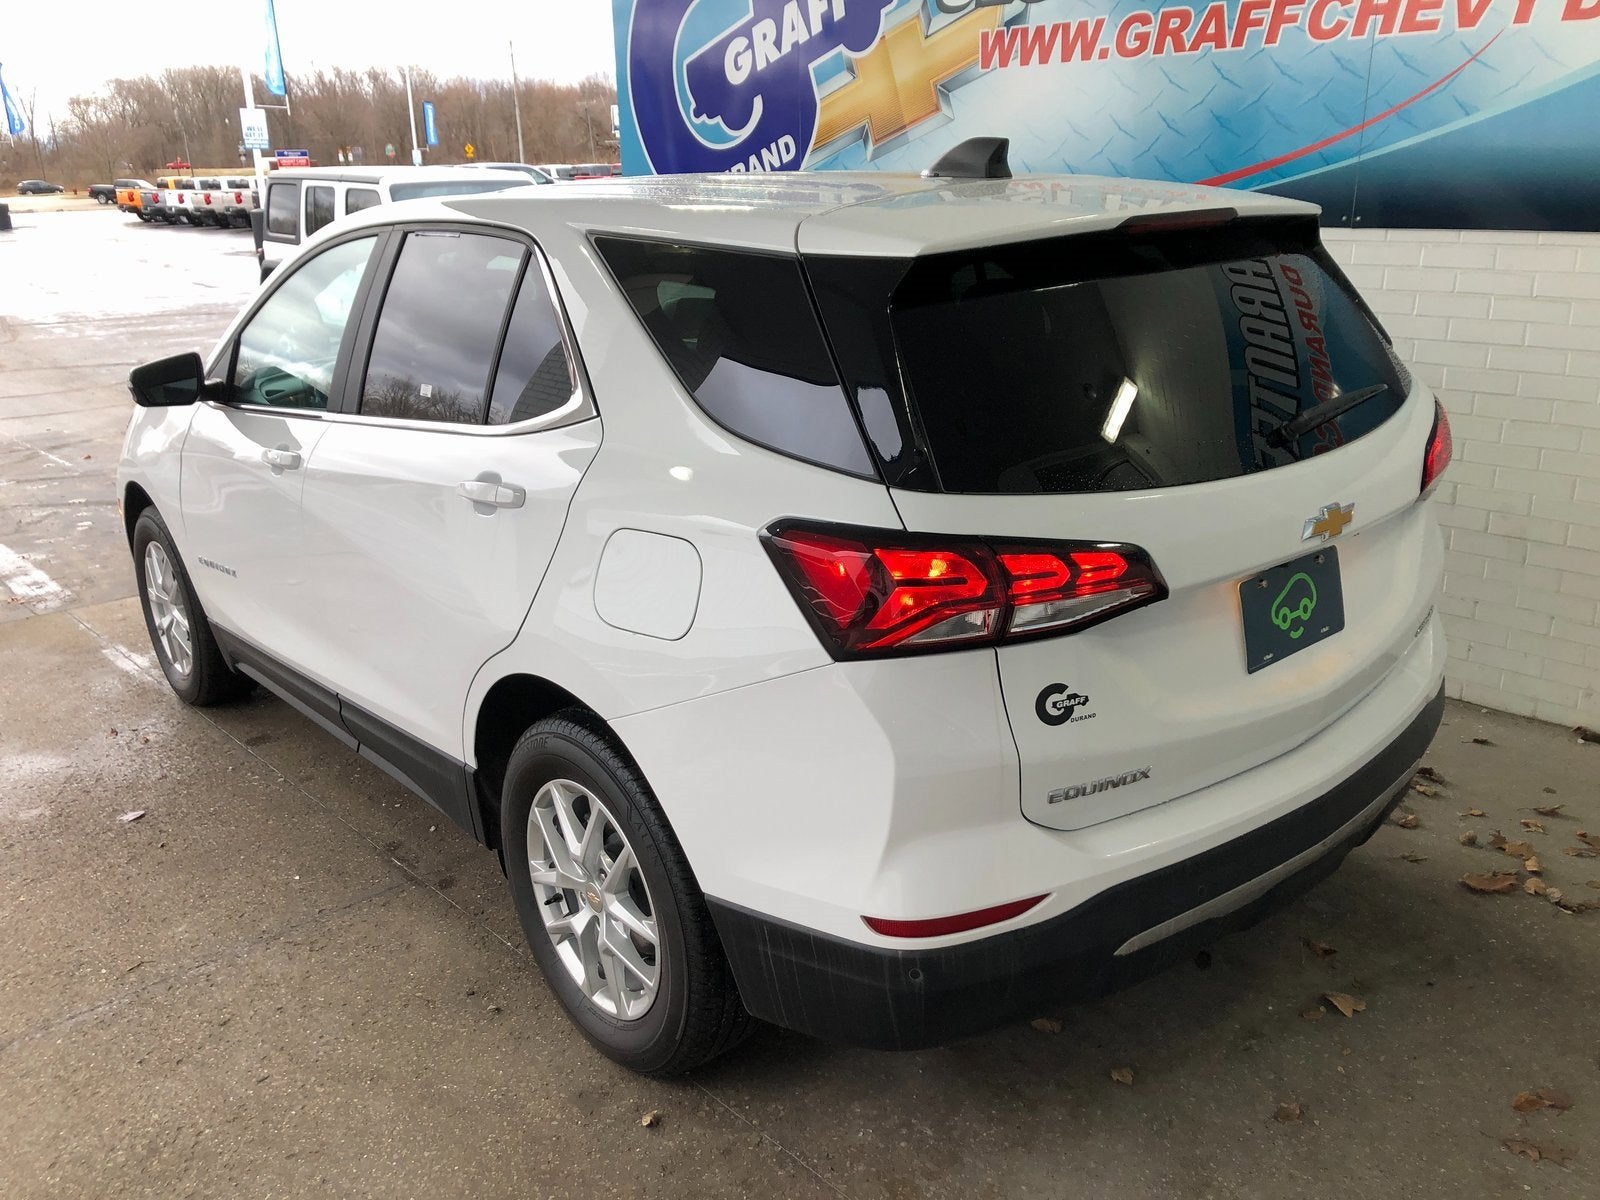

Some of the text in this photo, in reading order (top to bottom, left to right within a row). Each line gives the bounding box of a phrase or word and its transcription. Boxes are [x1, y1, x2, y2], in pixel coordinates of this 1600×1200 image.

[724, 134, 796, 173] AND
[1056, 696, 1087, 708] GRAFF
[1070, 712, 1097, 723] DURAND
[1047, 766, 1152, 804] EQUINOX
